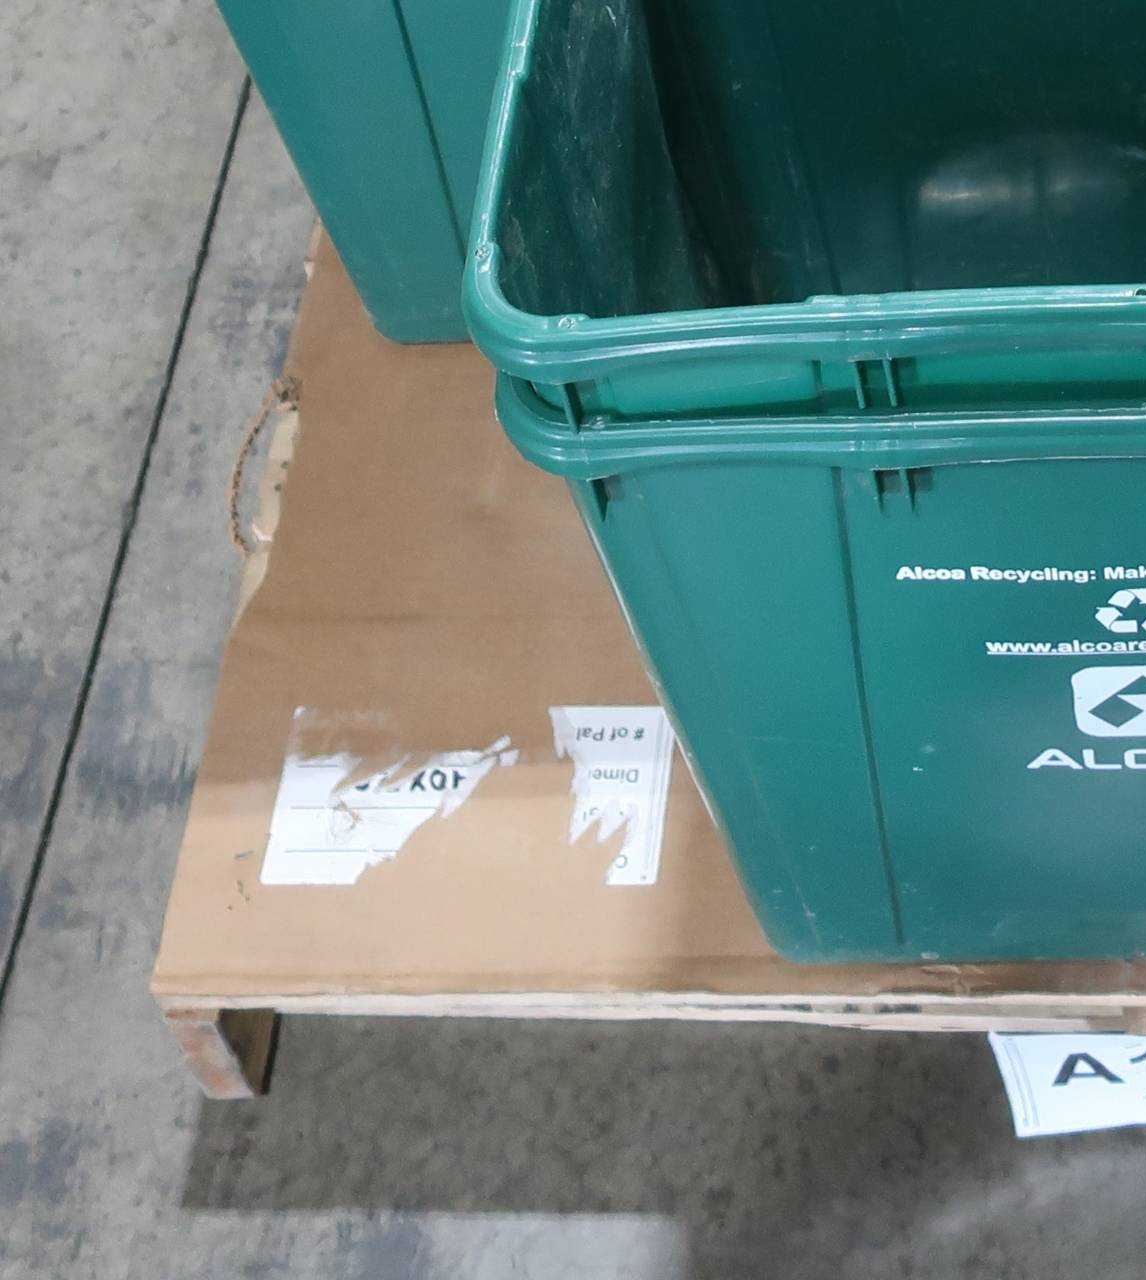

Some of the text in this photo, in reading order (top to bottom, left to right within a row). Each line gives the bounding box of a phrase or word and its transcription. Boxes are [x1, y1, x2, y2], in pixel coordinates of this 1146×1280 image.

[896, 566, 966, 581] Alcoa
[970, 565, 1097, 584] Recycling:
[587, 768, 640, 784] Dime
